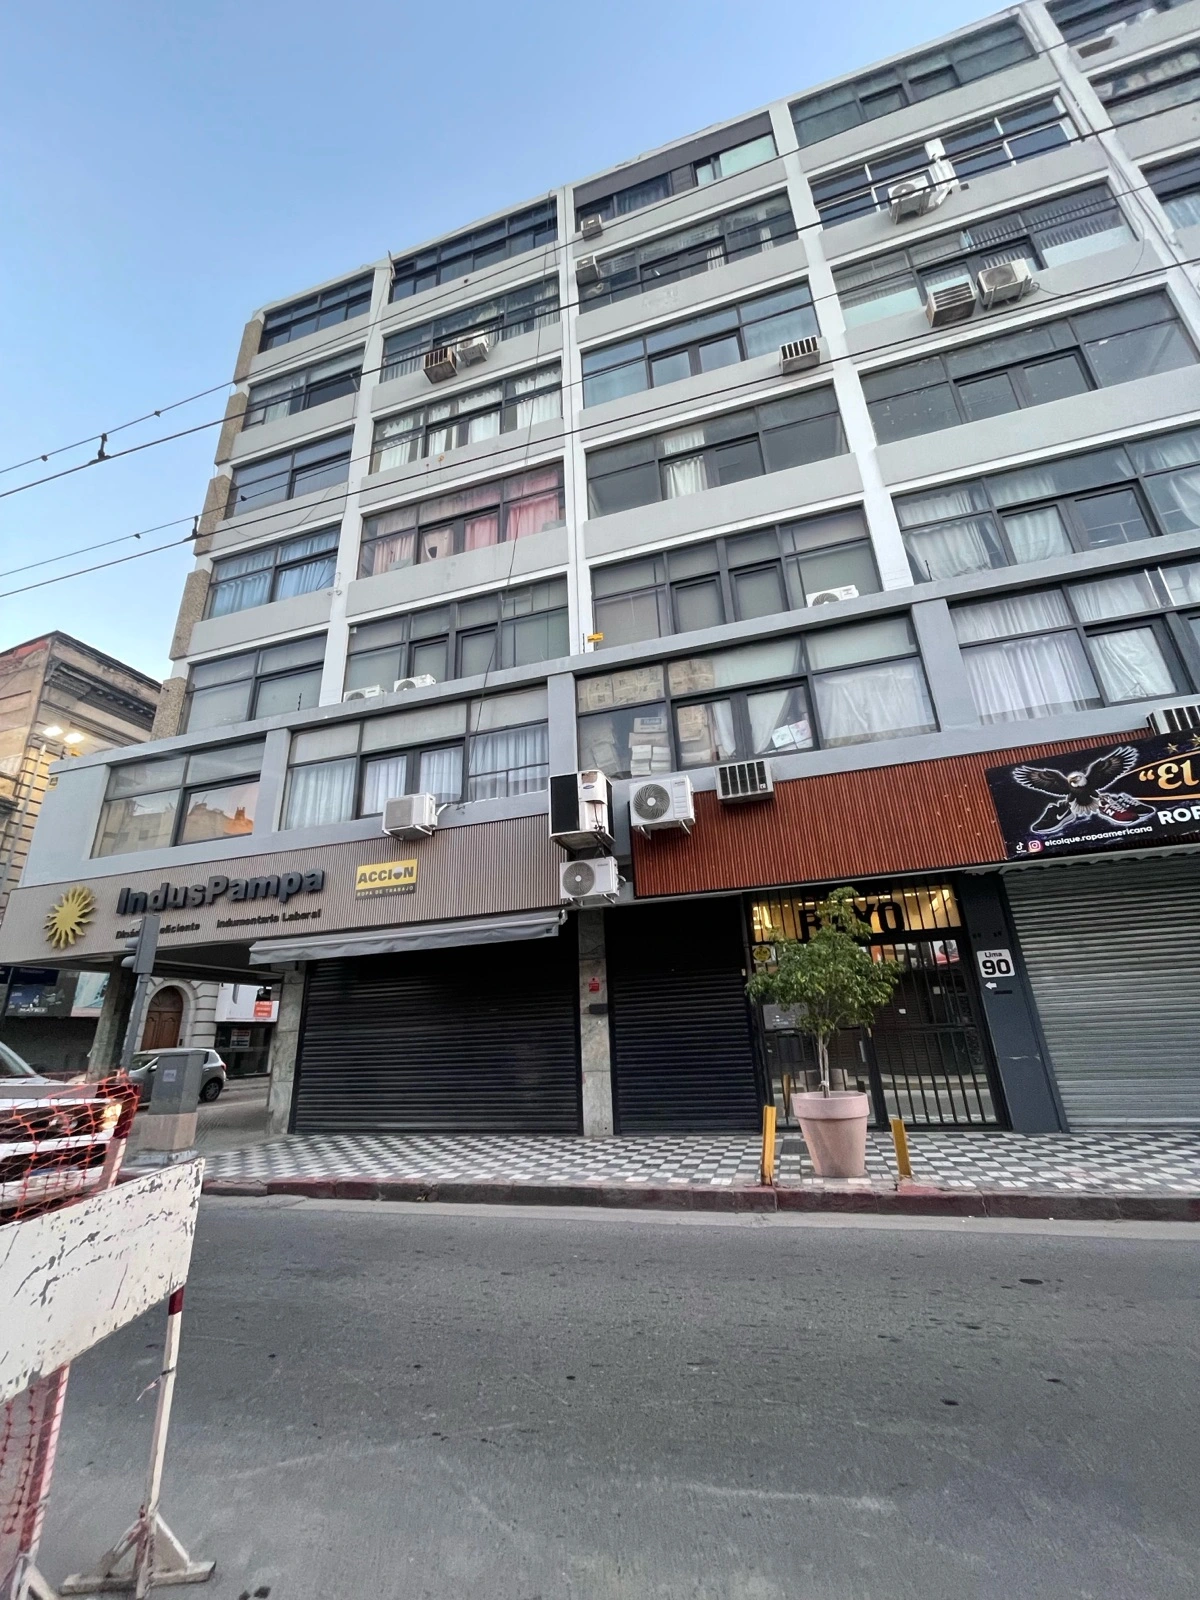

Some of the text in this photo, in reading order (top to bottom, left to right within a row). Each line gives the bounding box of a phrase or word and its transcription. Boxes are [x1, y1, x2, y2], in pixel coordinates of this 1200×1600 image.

[115, 868, 325, 915] IndusPampa
[385, 885, 414, 893] TRABAJO
[216, 908, 322, 929] Indumentaria Laboral
[981, 958, 1012, 976] 90
